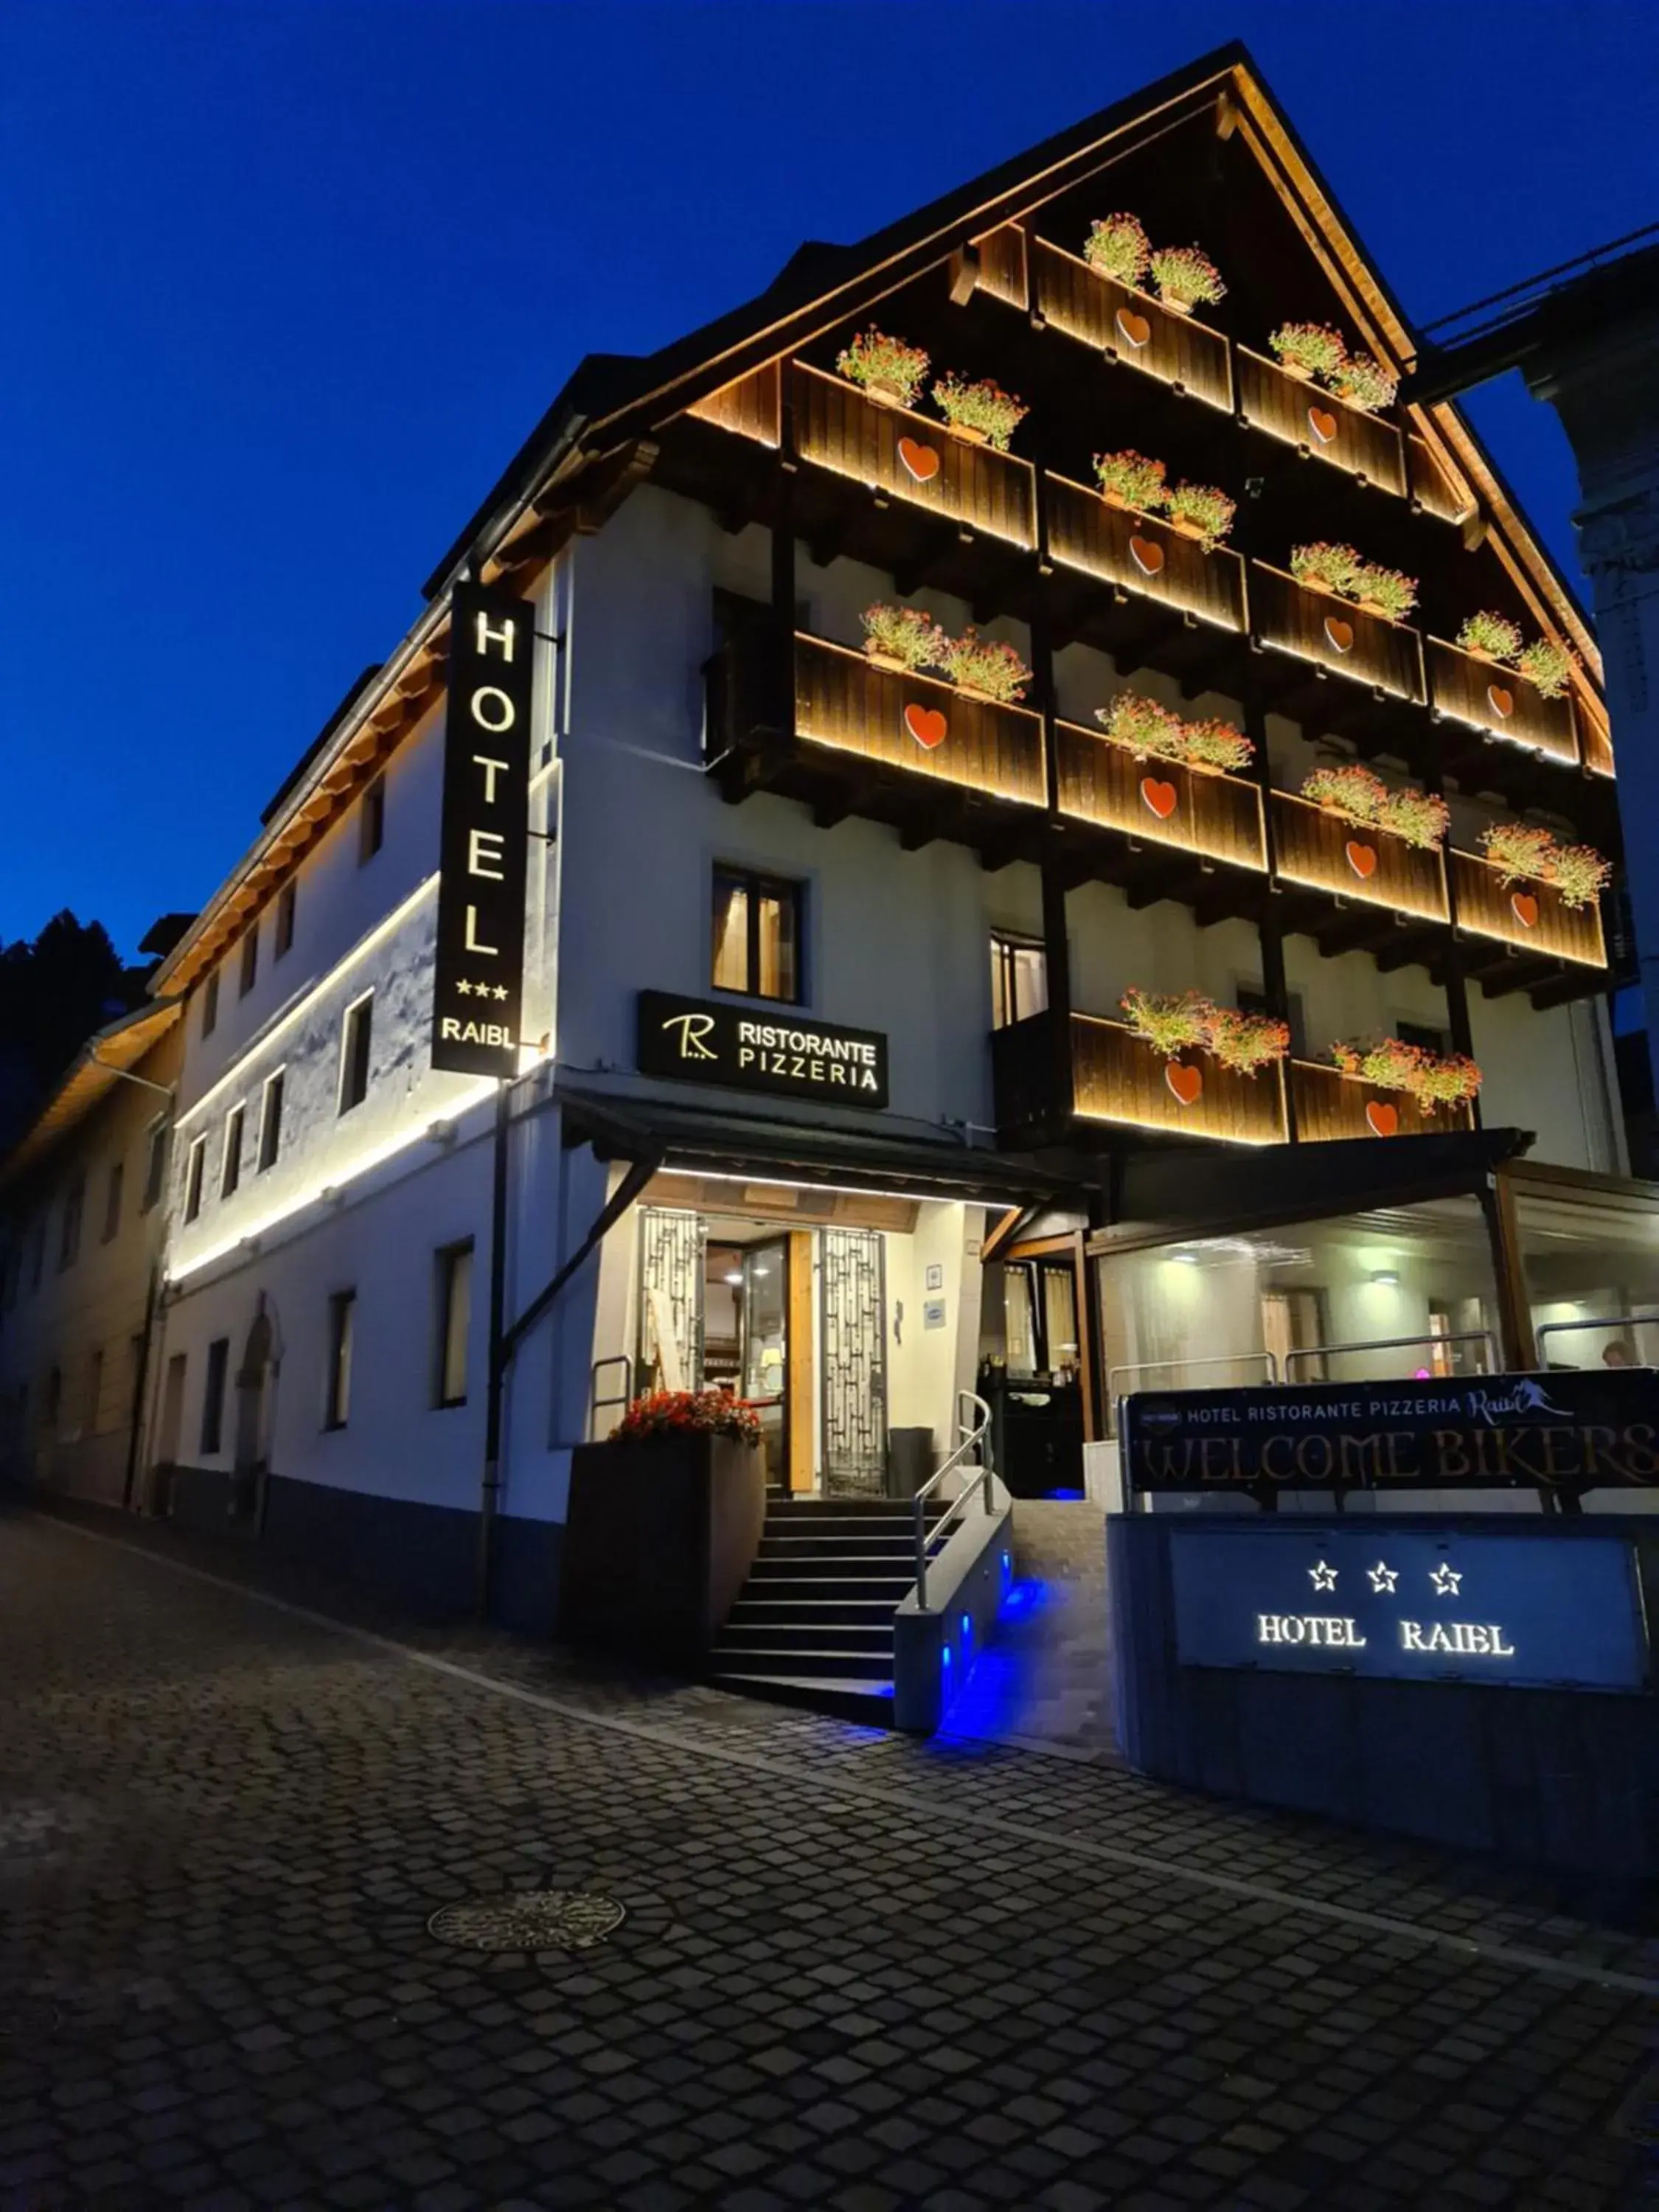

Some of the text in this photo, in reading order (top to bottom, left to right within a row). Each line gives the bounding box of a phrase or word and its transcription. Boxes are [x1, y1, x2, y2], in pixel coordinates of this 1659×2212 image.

[465, 611, 515, 956] HOTEL
[442, 1017, 515, 1049] RAIBL
[739, 1021, 876, 1066] RISTORANTE
[740, 1047, 877, 1091] PIZZERIA
[1187, 1407, 1241, 1424] HOTEL
[1248, 1400, 1363, 1422] RISTORANTE
[1368, 1397, 1461, 1416] PIZZERIA
[1141, 1422, 1659, 1489] WELCOME BIKERS
[1258, 1615, 1515, 1657] HOTEL RAIBL
